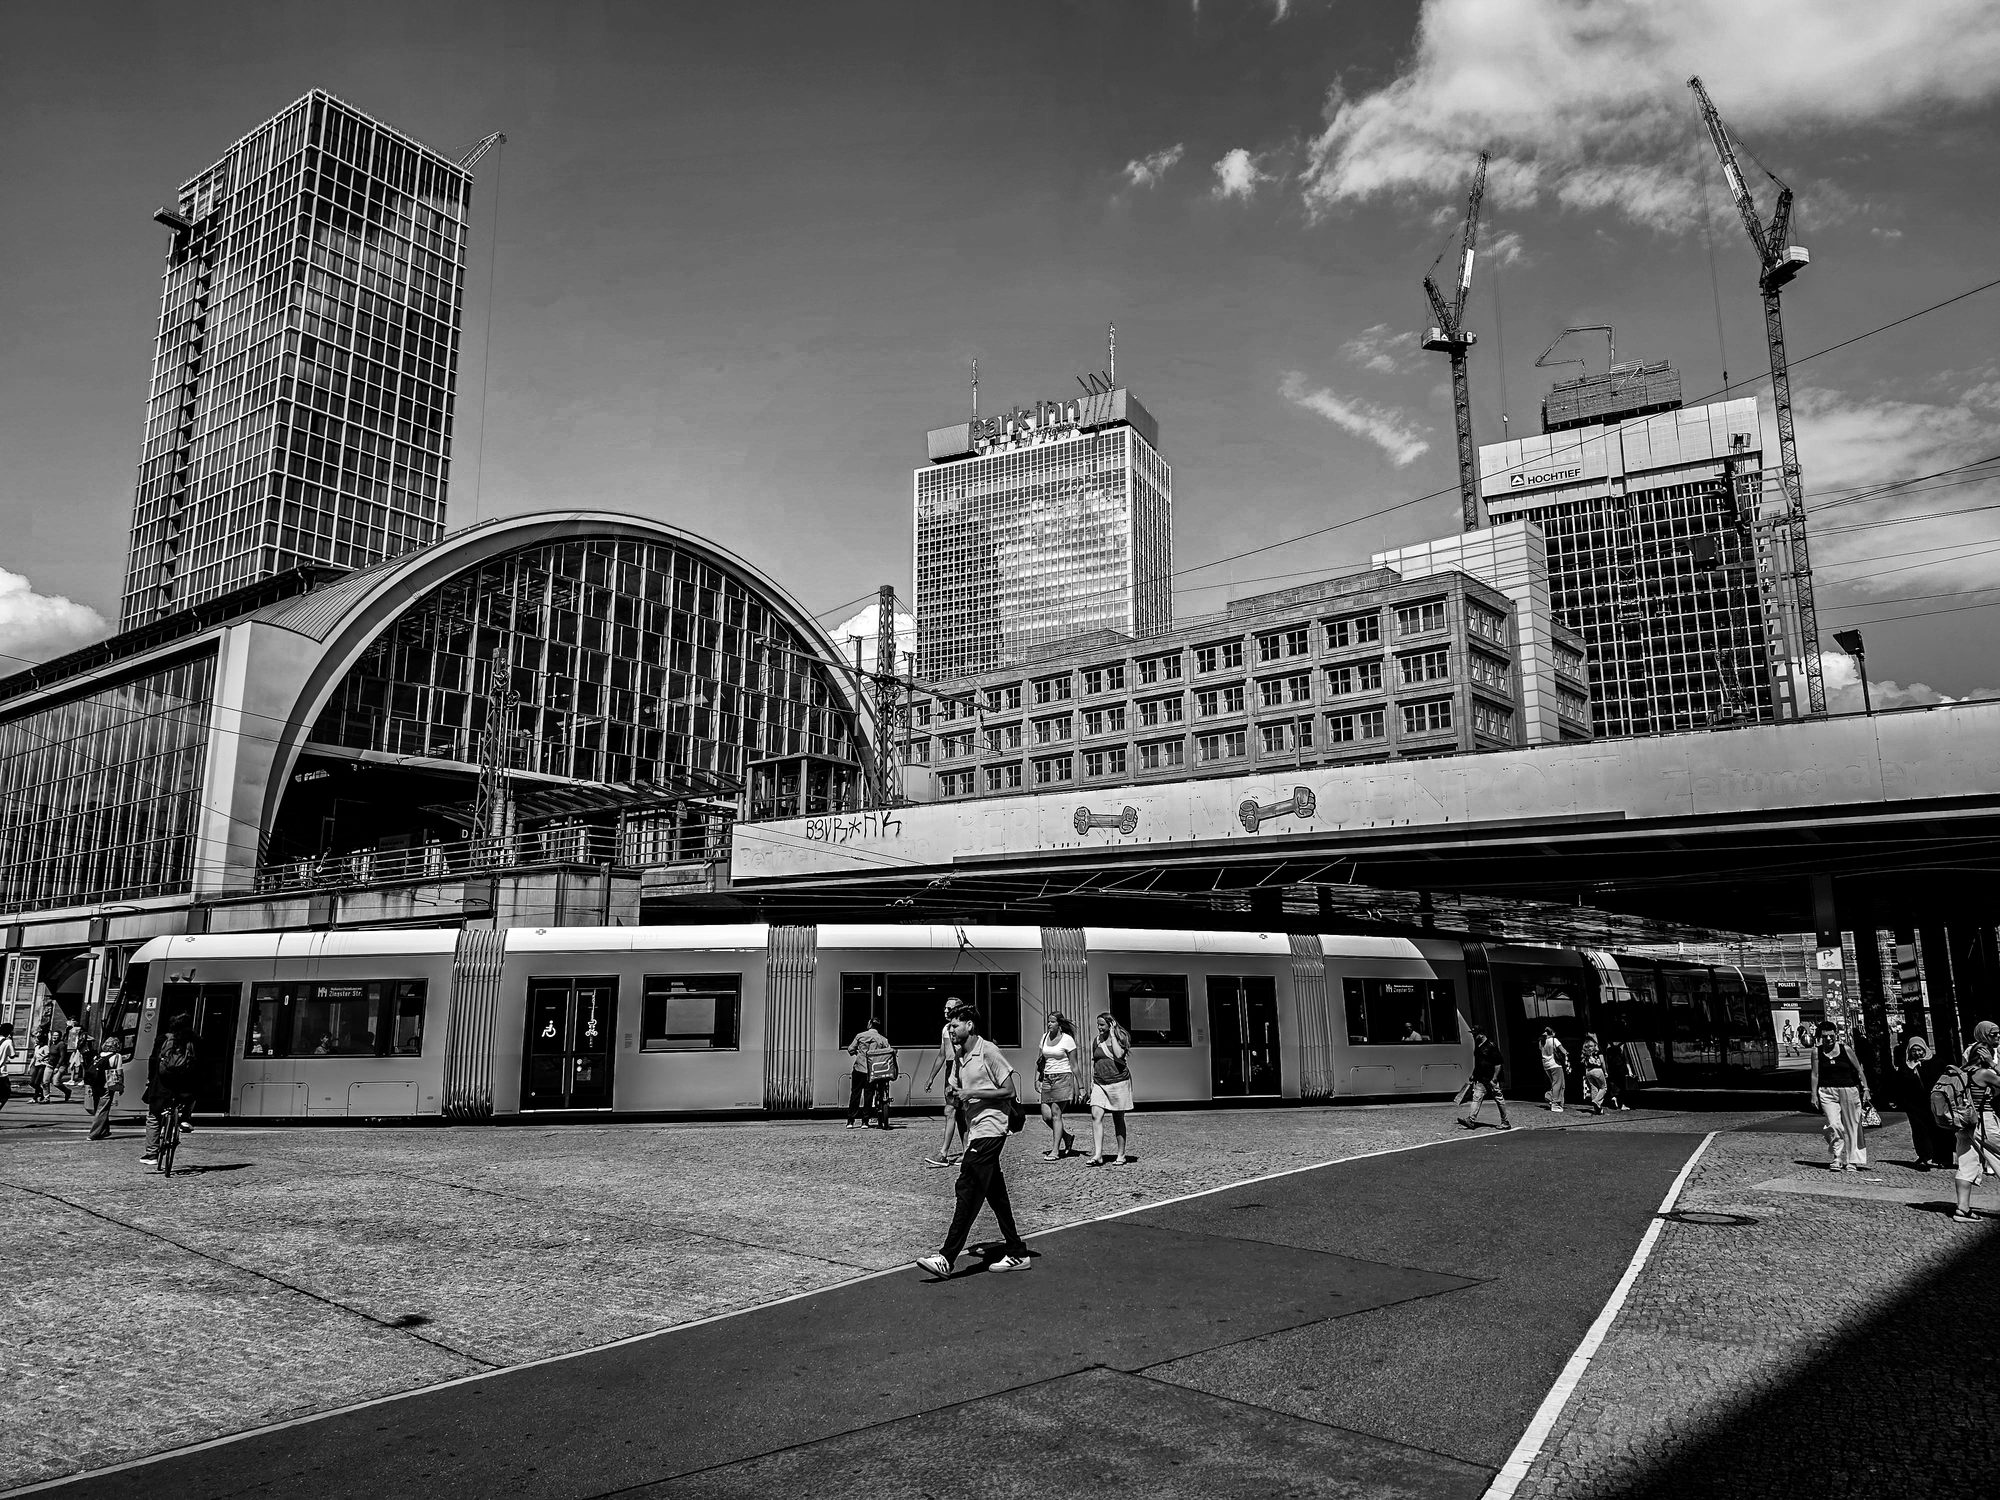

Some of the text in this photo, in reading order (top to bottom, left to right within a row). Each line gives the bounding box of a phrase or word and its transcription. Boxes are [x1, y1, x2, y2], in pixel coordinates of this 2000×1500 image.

[972, 399, 1081, 441] park inn
[1527, 467, 1581, 485] HOCHTIEF
